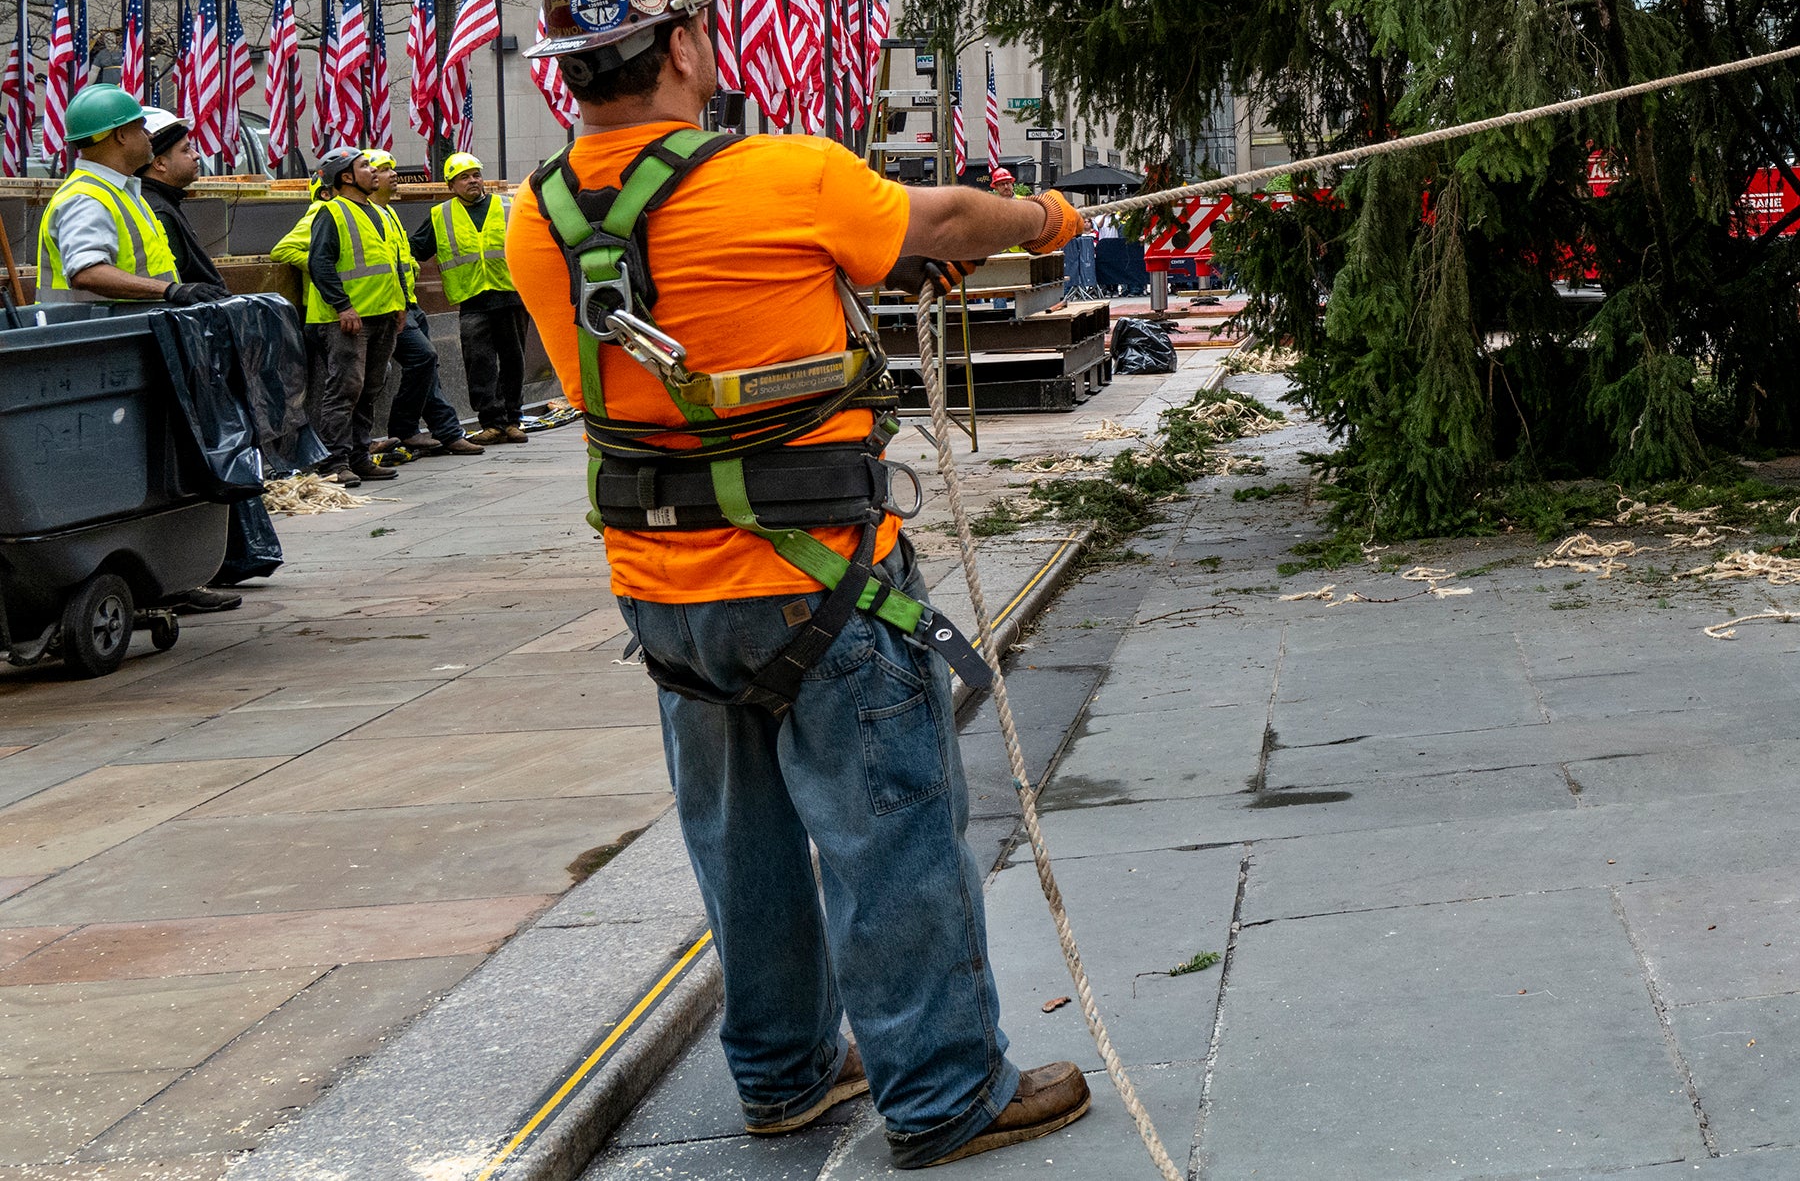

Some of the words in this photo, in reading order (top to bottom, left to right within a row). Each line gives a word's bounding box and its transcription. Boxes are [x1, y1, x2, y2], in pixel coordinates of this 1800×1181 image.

[397, 175, 429, 183] OMPANY
[792, 370, 807, 380] FALL
[808, 362, 843, 376] PROTECTION
[760, 384, 780, 395] Shock
[782, 378, 817, 391] Absorbing
[818, 373, 844, 385] Lanyard
